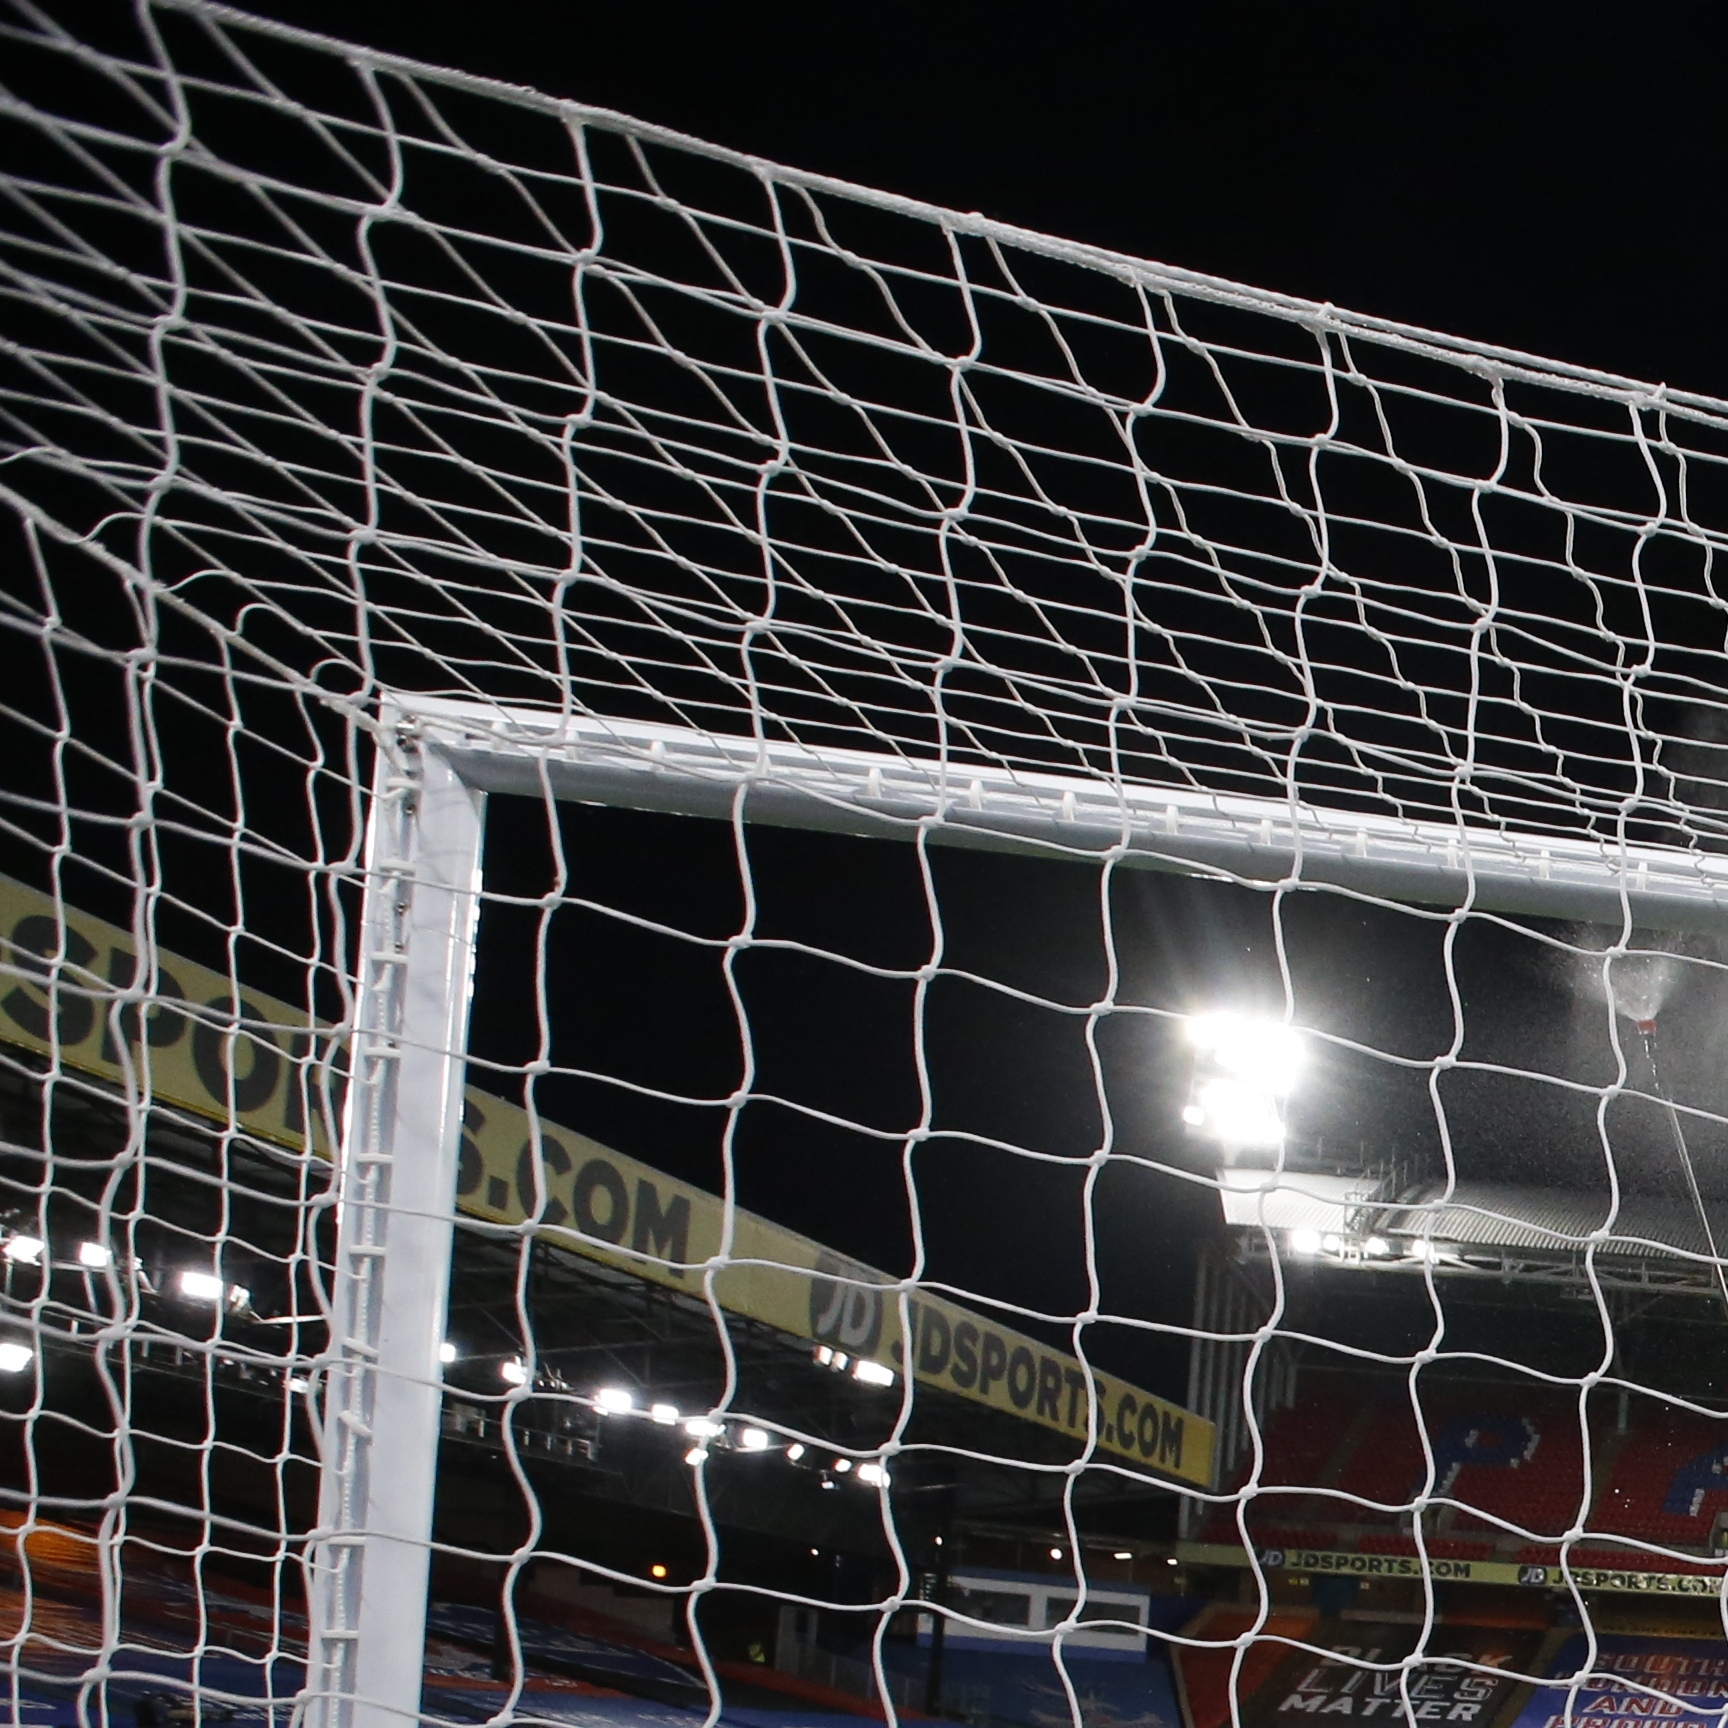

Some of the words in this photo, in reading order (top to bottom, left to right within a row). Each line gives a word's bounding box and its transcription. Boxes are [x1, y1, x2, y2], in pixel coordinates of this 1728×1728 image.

[1296, 1667, 1500, 1701] LIVES
[1277, 1694, 1483, 1722] MATTER
[1582, 1696, 1686, 1718] AND
